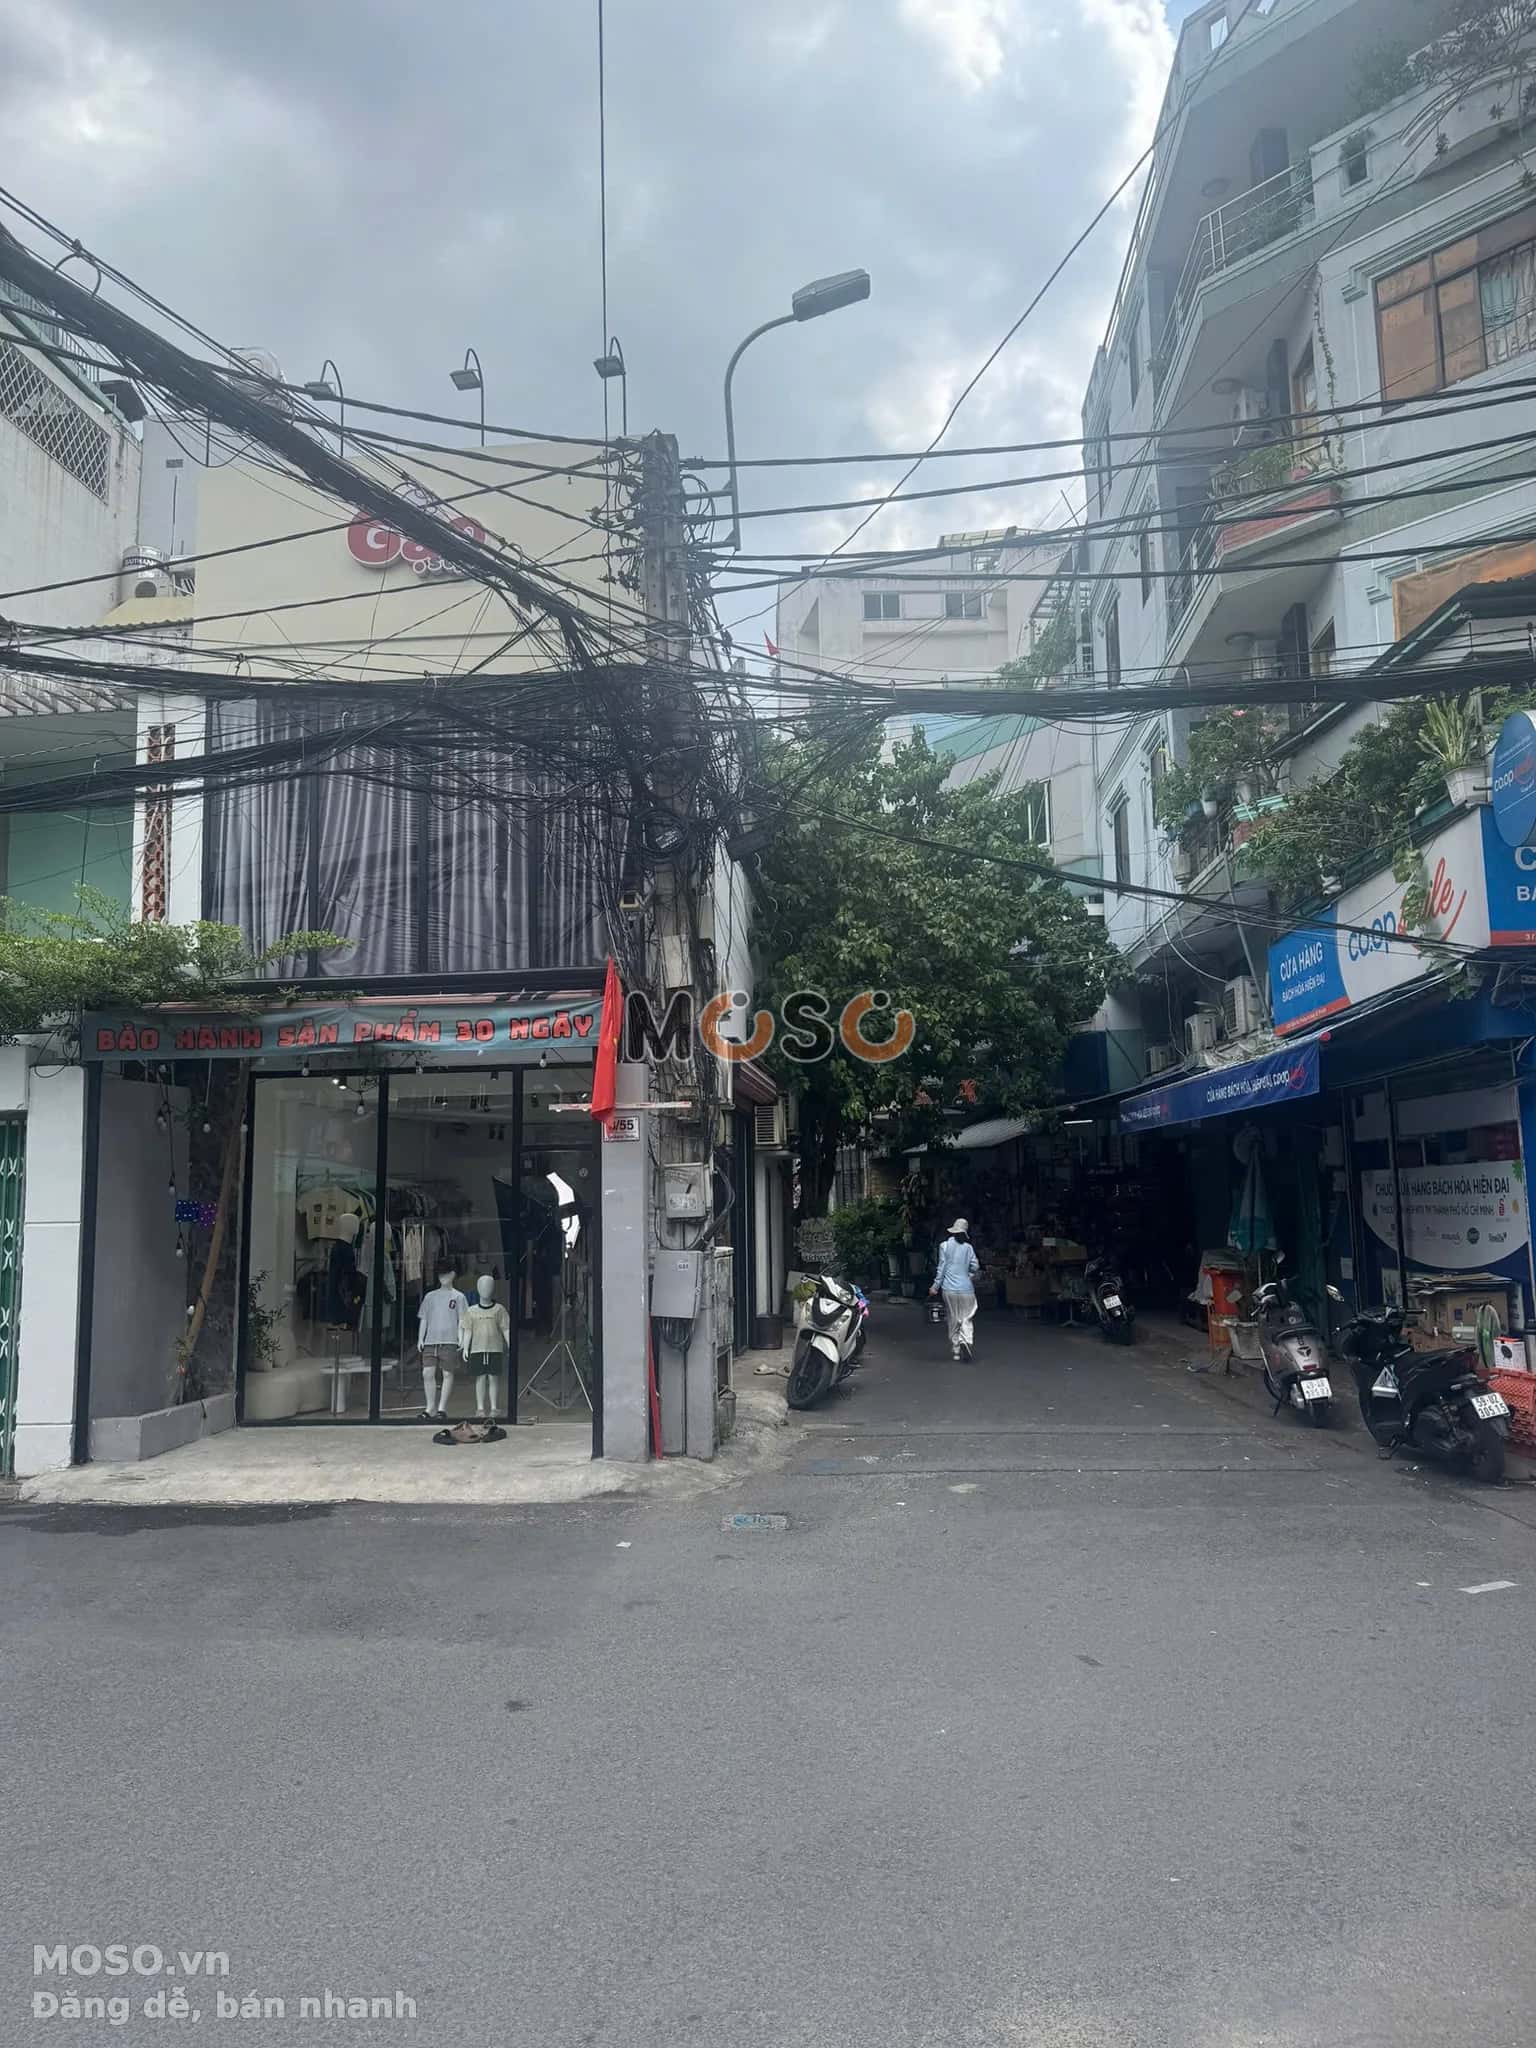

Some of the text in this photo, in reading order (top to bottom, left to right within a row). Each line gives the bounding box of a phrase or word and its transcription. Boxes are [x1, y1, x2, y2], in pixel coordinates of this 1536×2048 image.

[1299, 941, 1323, 972] HÀNG
[97, 1021, 160, 1051] BẢO
[455, 1018, 496, 1042] 30
[1473, 1174, 1493, 1199] HIỆN
[1494, 1177, 1509, 1198] ĐẠI
